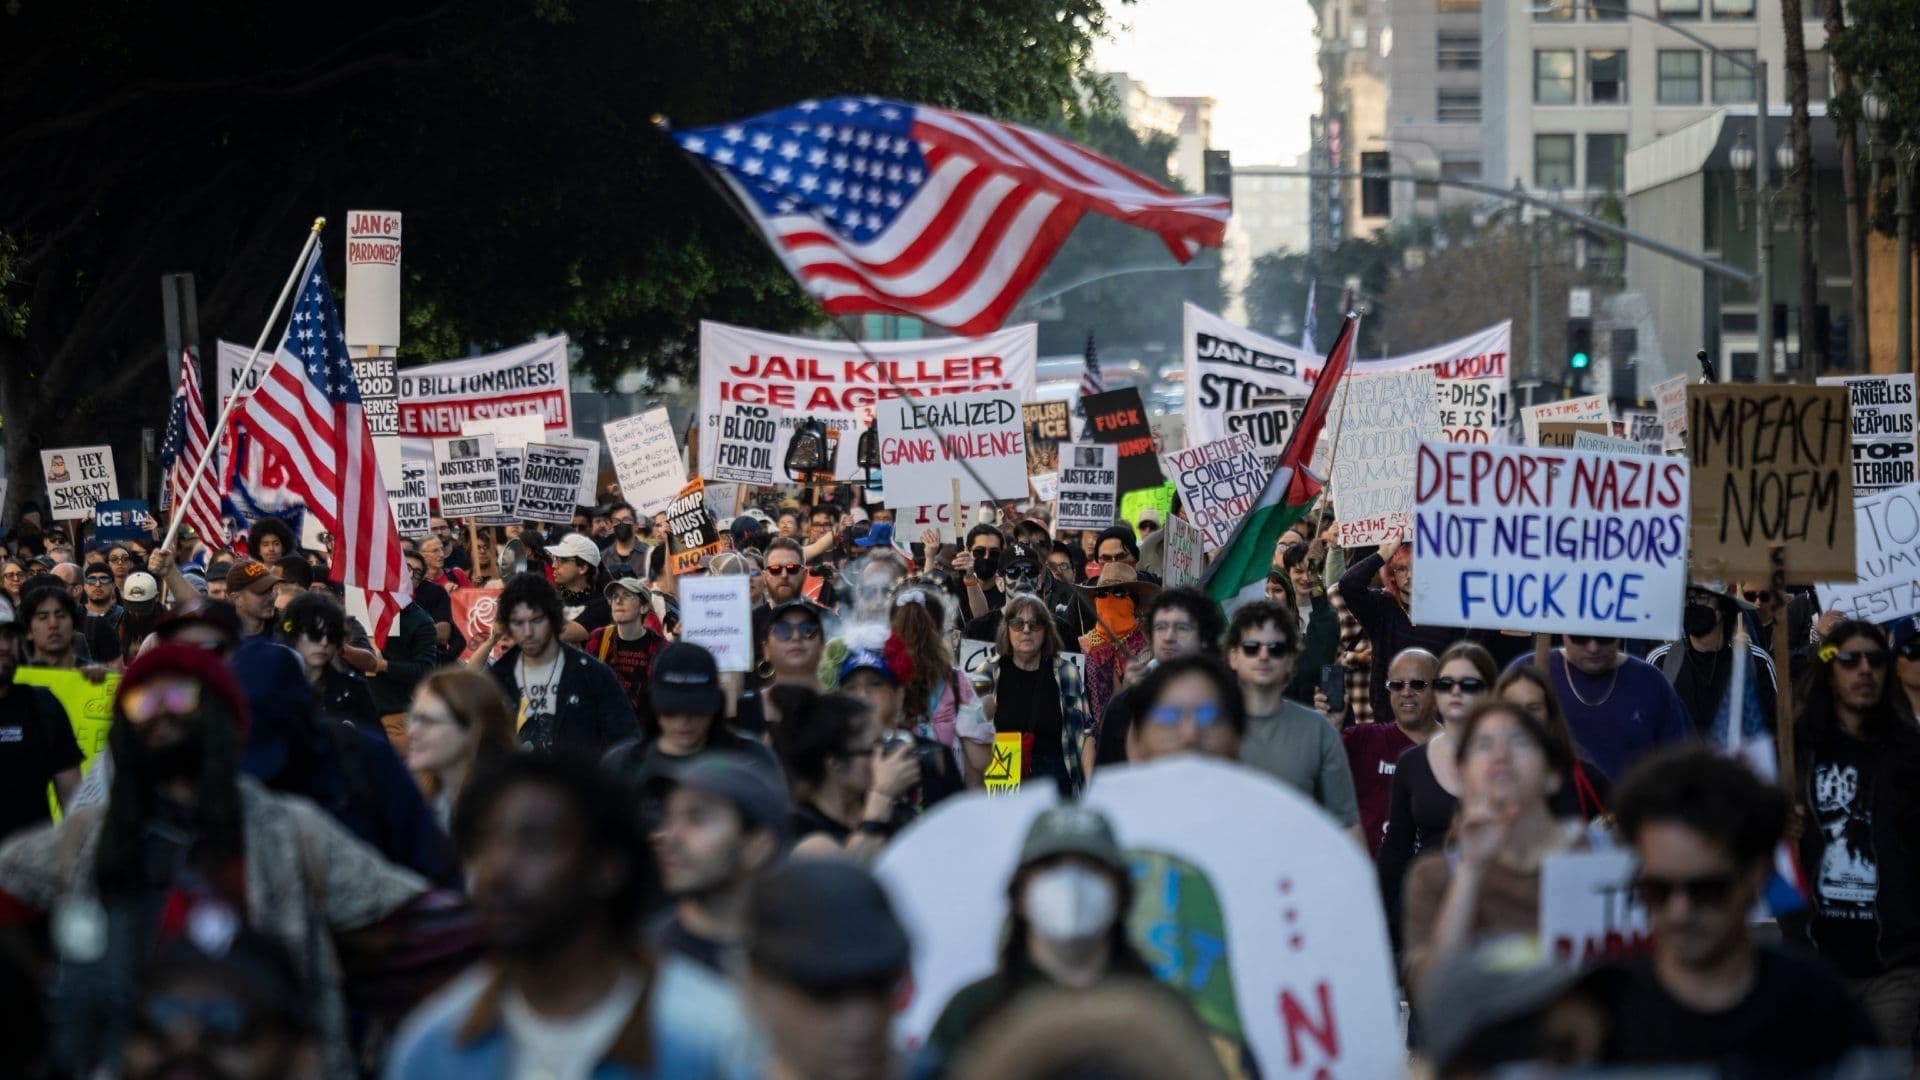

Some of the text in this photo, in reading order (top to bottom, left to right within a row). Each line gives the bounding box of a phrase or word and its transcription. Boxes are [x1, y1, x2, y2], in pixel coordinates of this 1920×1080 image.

[351, 214, 399, 235] JAN 6th
[349, 242, 401, 263] PARDONED?
[1198, 339, 1254, 366] JAN
[418, 362, 556, 397] BILLIONAIRES!
[730, 355, 1003, 383] JAIL KILLER
[720, 382, 796, 409] ICE
[1852, 384, 1912, 406] ANGELES
[735, 405, 769, 418] NO
[901, 399, 1016, 430] LEGALIZED
[1556, 402, 1580, 415] TIME
[1584, 400, 1600, 411] WE
[1858, 409, 1878, 417] TO
[723, 416, 776, 443] BLOOD
[1039, 420, 1067, 438] ICE
[1096, 409, 1140, 432] FUCK
[1228, 410, 1289, 447] STOP
[1464, 411, 1485, 427] IS
[1693, 395, 1849, 469] IMPEACH
[78, 452, 103, 467] HEY
[718, 444, 773, 470] FOR OIL
[881, 431, 1024, 466] GANG VIOLENCE
[1169, 433, 1256, 472] YOU EITHER
[440, 459, 496, 476] JUSTICE FOR
[528, 454, 584, 468] STOP
[1180, 451, 1261, 489] CONDEM
[524, 464, 581, 486] BOMBING
[1060, 469, 1115, 485] JUSTICE FOR
[1416, 444, 1685, 512] DEPORT NAZIS
[1854, 461, 1915, 484] TERROR
[54, 481, 111, 506] SUCK MY
[441, 479, 497, 492] RENEE
[521, 484, 577, 503] VENEZUELA
[1185, 469, 1268, 512] FACISM
[442, 491, 473, 506] NICOLE
[473, 490, 499, 504] GOOD
[519, 498, 574, 513] NOW!
[667, 491, 703, 520] TRUMP
[1060, 491, 1113, 503] RENEE
[97, 512, 122, 526] ICE
[1060, 502, 1113, 518] NICOLE GOOD
[1194, 506, 1220, 528] OR
[1720, 468, 1840, 549] NOEM
[669, 508, 705, 535] MUST
[683, 529, 704, 549] GO
[1417, 511, 1487, 559] NOT
[1460, 571, 1651, 622] FUCK ICE.
